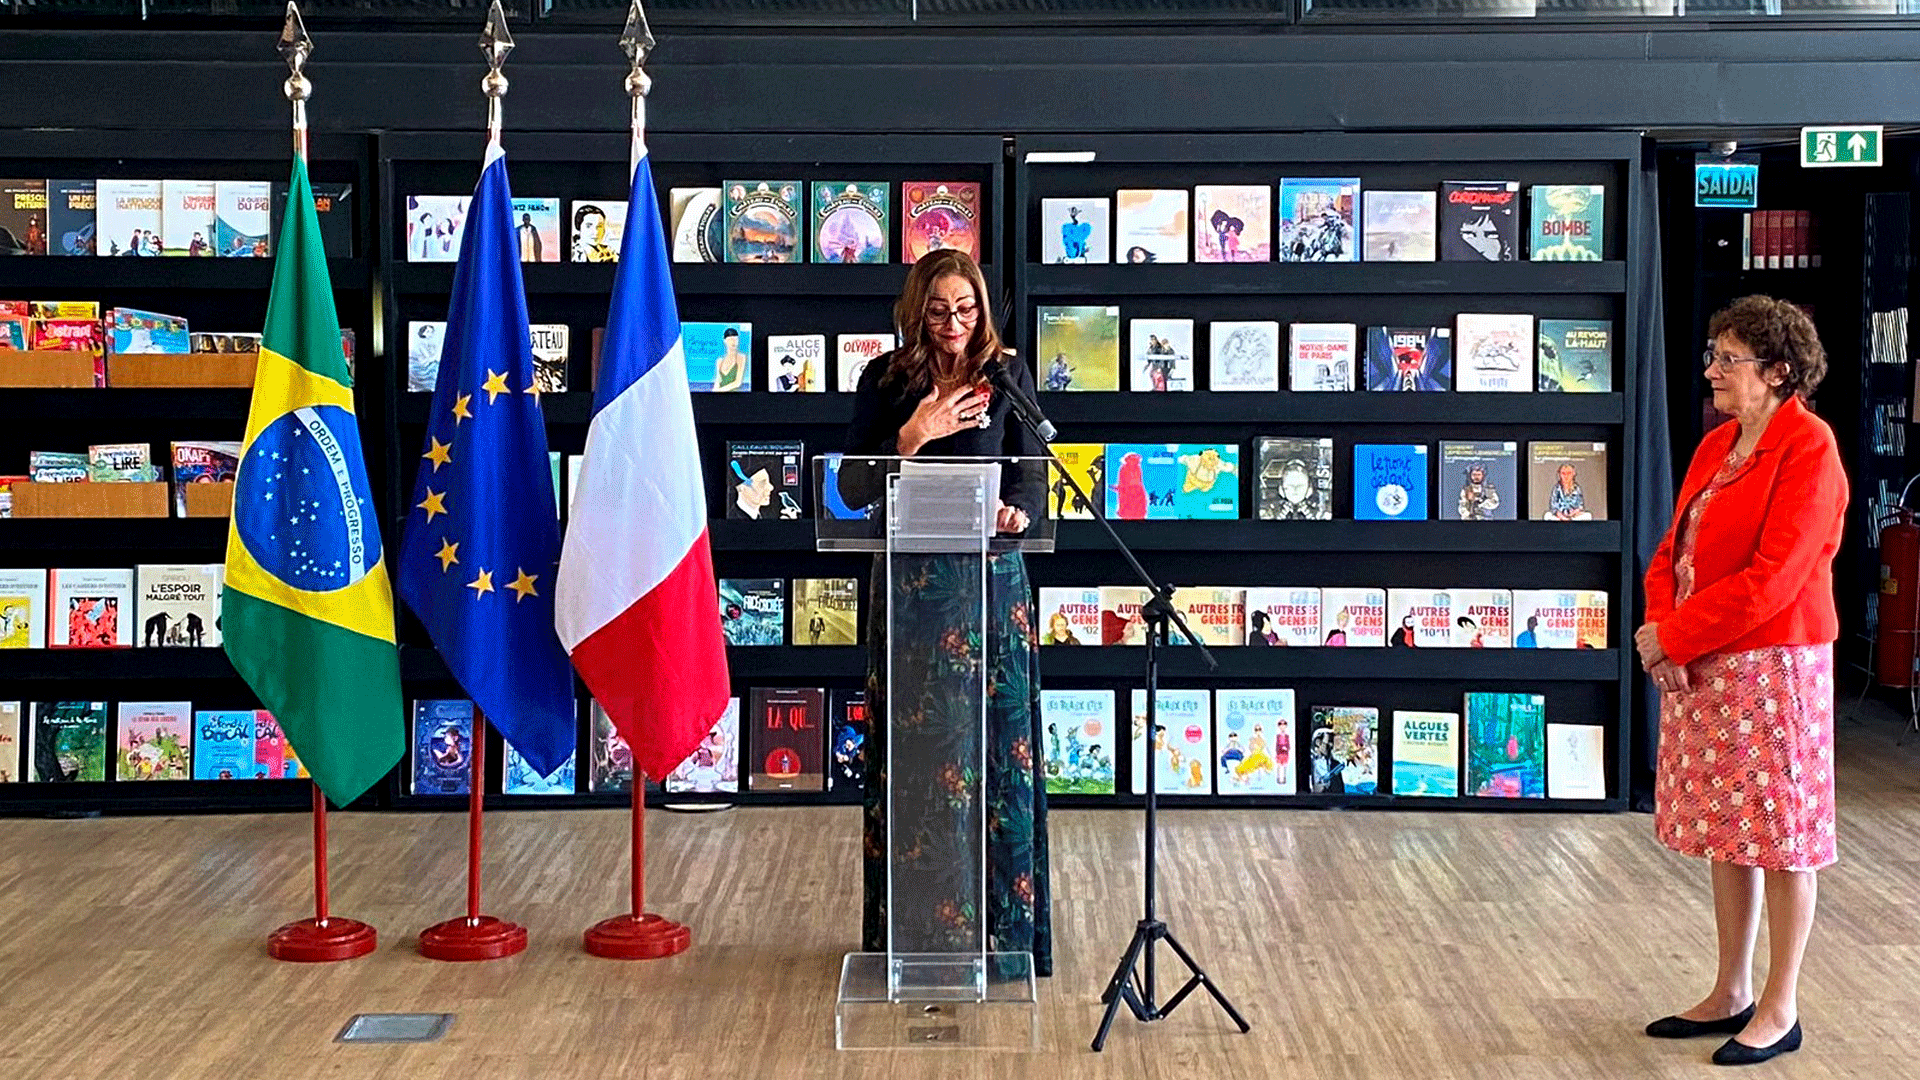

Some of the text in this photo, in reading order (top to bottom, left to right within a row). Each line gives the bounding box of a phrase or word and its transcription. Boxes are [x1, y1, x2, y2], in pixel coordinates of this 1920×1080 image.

[1699, 171, 1753, 195] SAÍDA
[1542, 220, 1592, 235] BOMBE
[786, 340, 820, 348] ALICE
[1394, 335, 1426, 348] 1984
[795, 348, 820, 358] GUY
[843, 341, 883, 354] OLYMPE
[113, 456, 141, 470] LIRE
[309, 420, 362, 565] ORDEM E PROGRESSO
[151, 583, 201, 593] L'ESPOIR
[146, 592, 206, 601] MALGRÉ TOUT
[1082, 591, 1099, 604] LES
[1366, 594, 1382, 605] LES
[1433, 593, 1450, 605] LES
[1492, 594, 1509, 606] LES
[1558, 594, 1576, 606] LES
[1058, 604, 1099, 614] AUTRES
[1188, 604, 1229, 615] AUTRES
[1267, 605, 1306, 615] AUTRES
[1344, 606, 1382, 616] AUTRES
[1409, 606, 1450, 617] AUTRES
[1468, 606, 1509, 617] AUTRES
[1534, 607, 1575, 617] AUTRES
[1071, 614, 1099, 624] GENS
[1201, 614, 1229, 624] GENS
[1279, 616, 1307, 625] GENS
[1355, 616, 1382, 626] GENS
[1422, 617, 1450, 626] GENS
[1480, 617, 1509, 626] GENS
[1547, 618, 1575, 628] GENS
[1577, 618, 1605, 628] GENS
[768, 706, 783, 728] LA
[1403, 720, 1450, 731] ALGUES
[1405, 731, 1449, 742] VERTES
